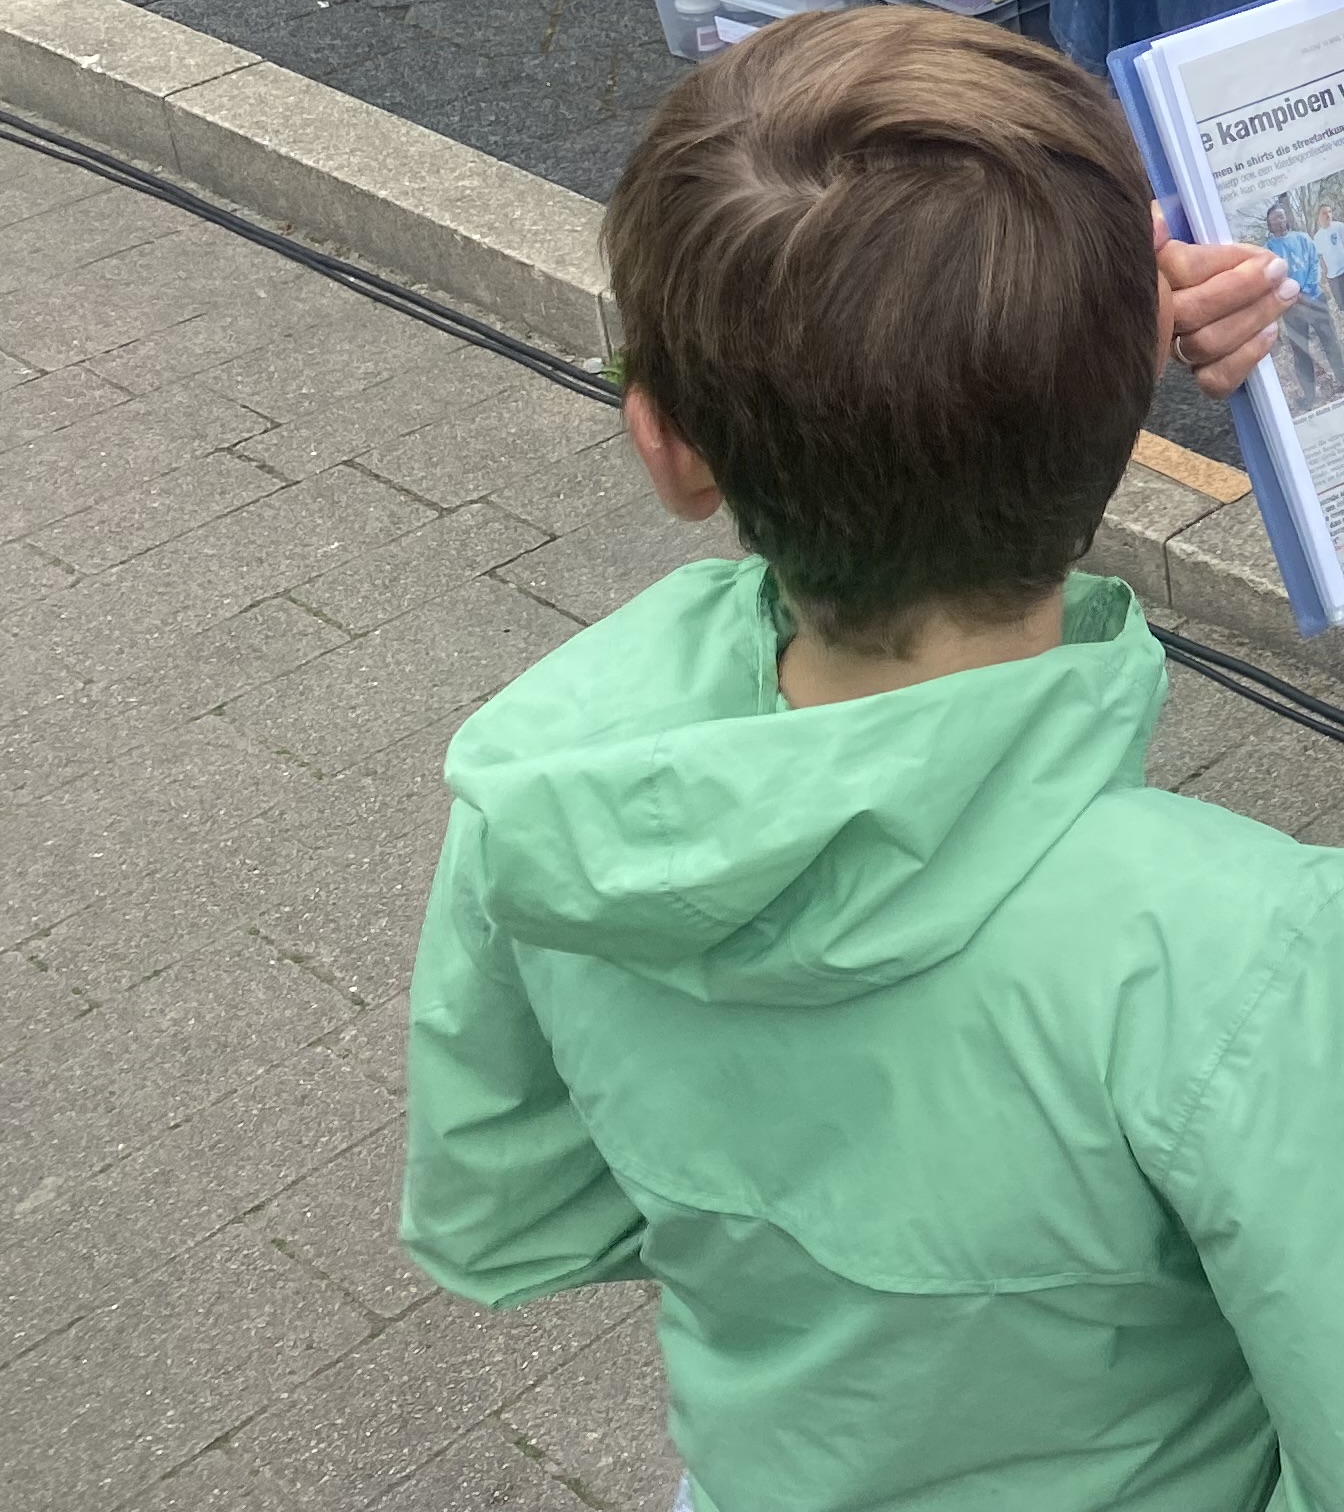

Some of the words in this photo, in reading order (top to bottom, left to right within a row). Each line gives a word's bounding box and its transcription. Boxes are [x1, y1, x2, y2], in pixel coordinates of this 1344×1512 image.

[1216, 88, 1335, 145] kampioen
[1246, 151, 1275, 167] shirts
[1275, 146, 1291, 157] die
